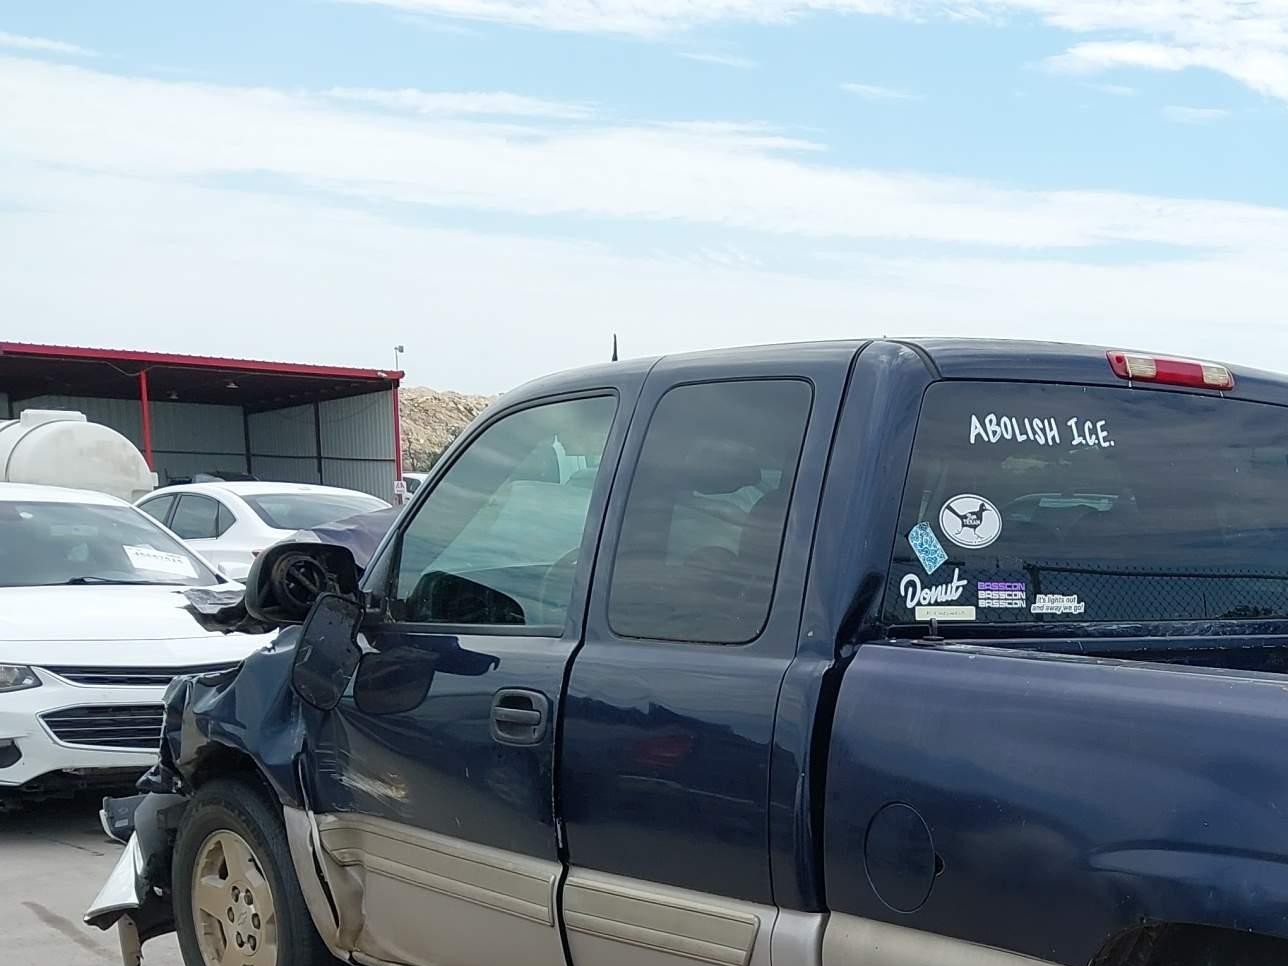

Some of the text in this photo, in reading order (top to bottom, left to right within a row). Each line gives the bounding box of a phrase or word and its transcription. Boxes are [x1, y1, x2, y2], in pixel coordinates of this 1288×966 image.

[970, 413, 1115, 447] ABOLISH I.C.E.
[900, 567, 968, 609] Donut
[978, 582, 1026, 591] BASSCON
[978, 591, 1026, 599] BASSCON
[978, 600, 1027, 608] BASSCON
[1066, 596, 1076, 604] out
